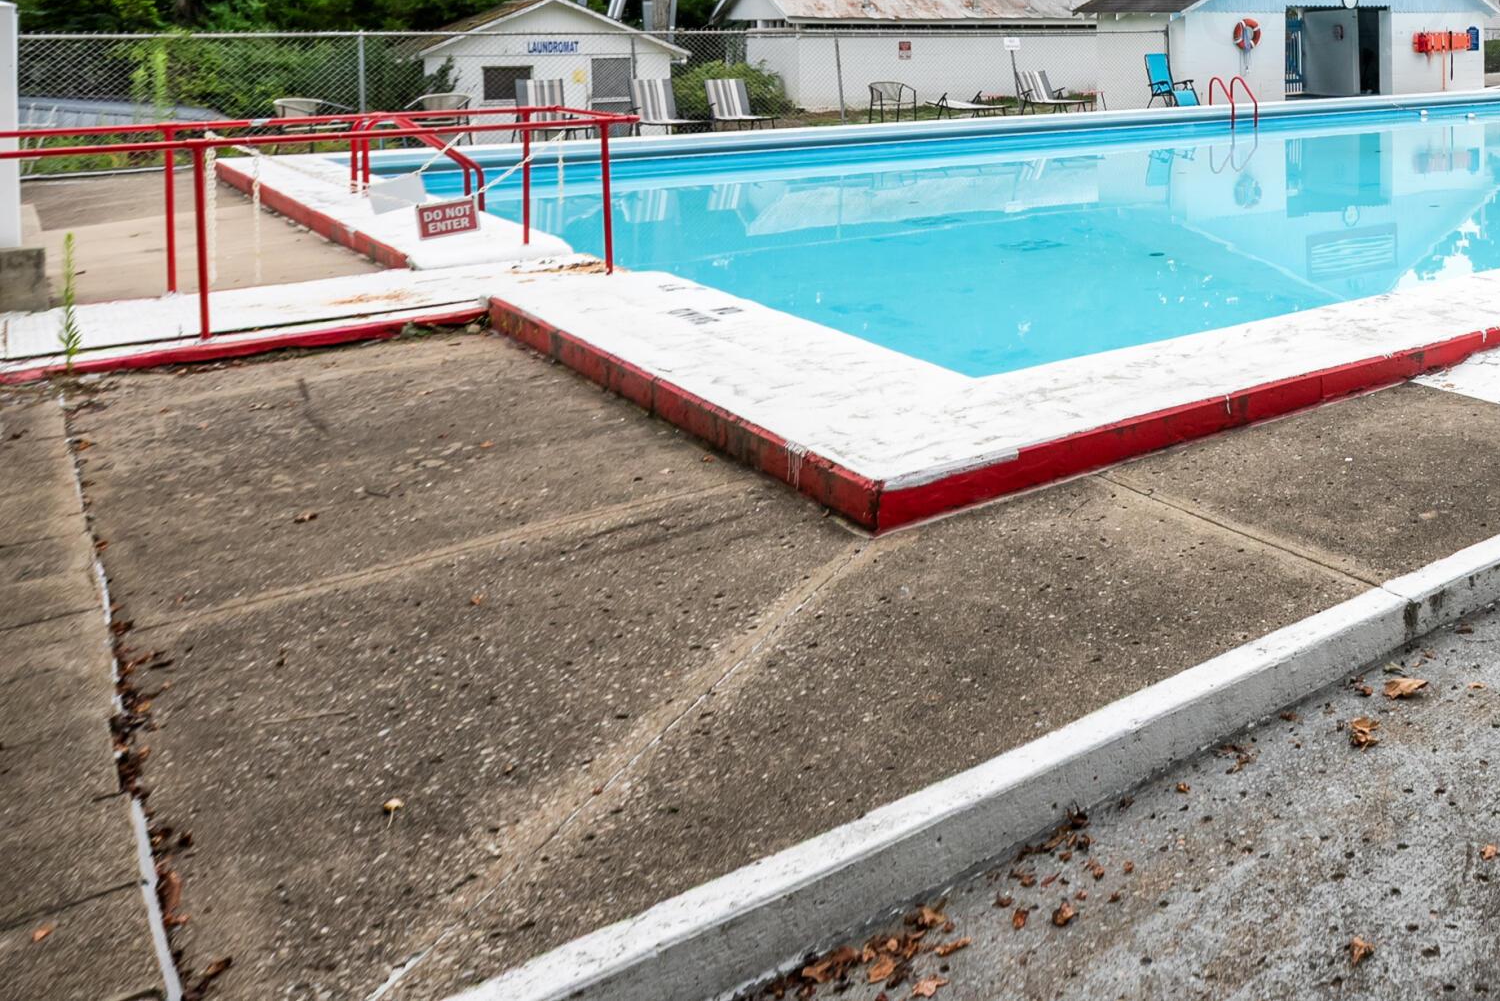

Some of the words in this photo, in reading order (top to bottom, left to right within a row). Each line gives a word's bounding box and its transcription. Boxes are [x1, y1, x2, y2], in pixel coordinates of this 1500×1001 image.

[528, 41, 579, 53] LAUNDROMAT
[423, 210, 442, 222] DO
[445, 204, 471, 218] NOT
[428, 217, 470, 233] ENTER
